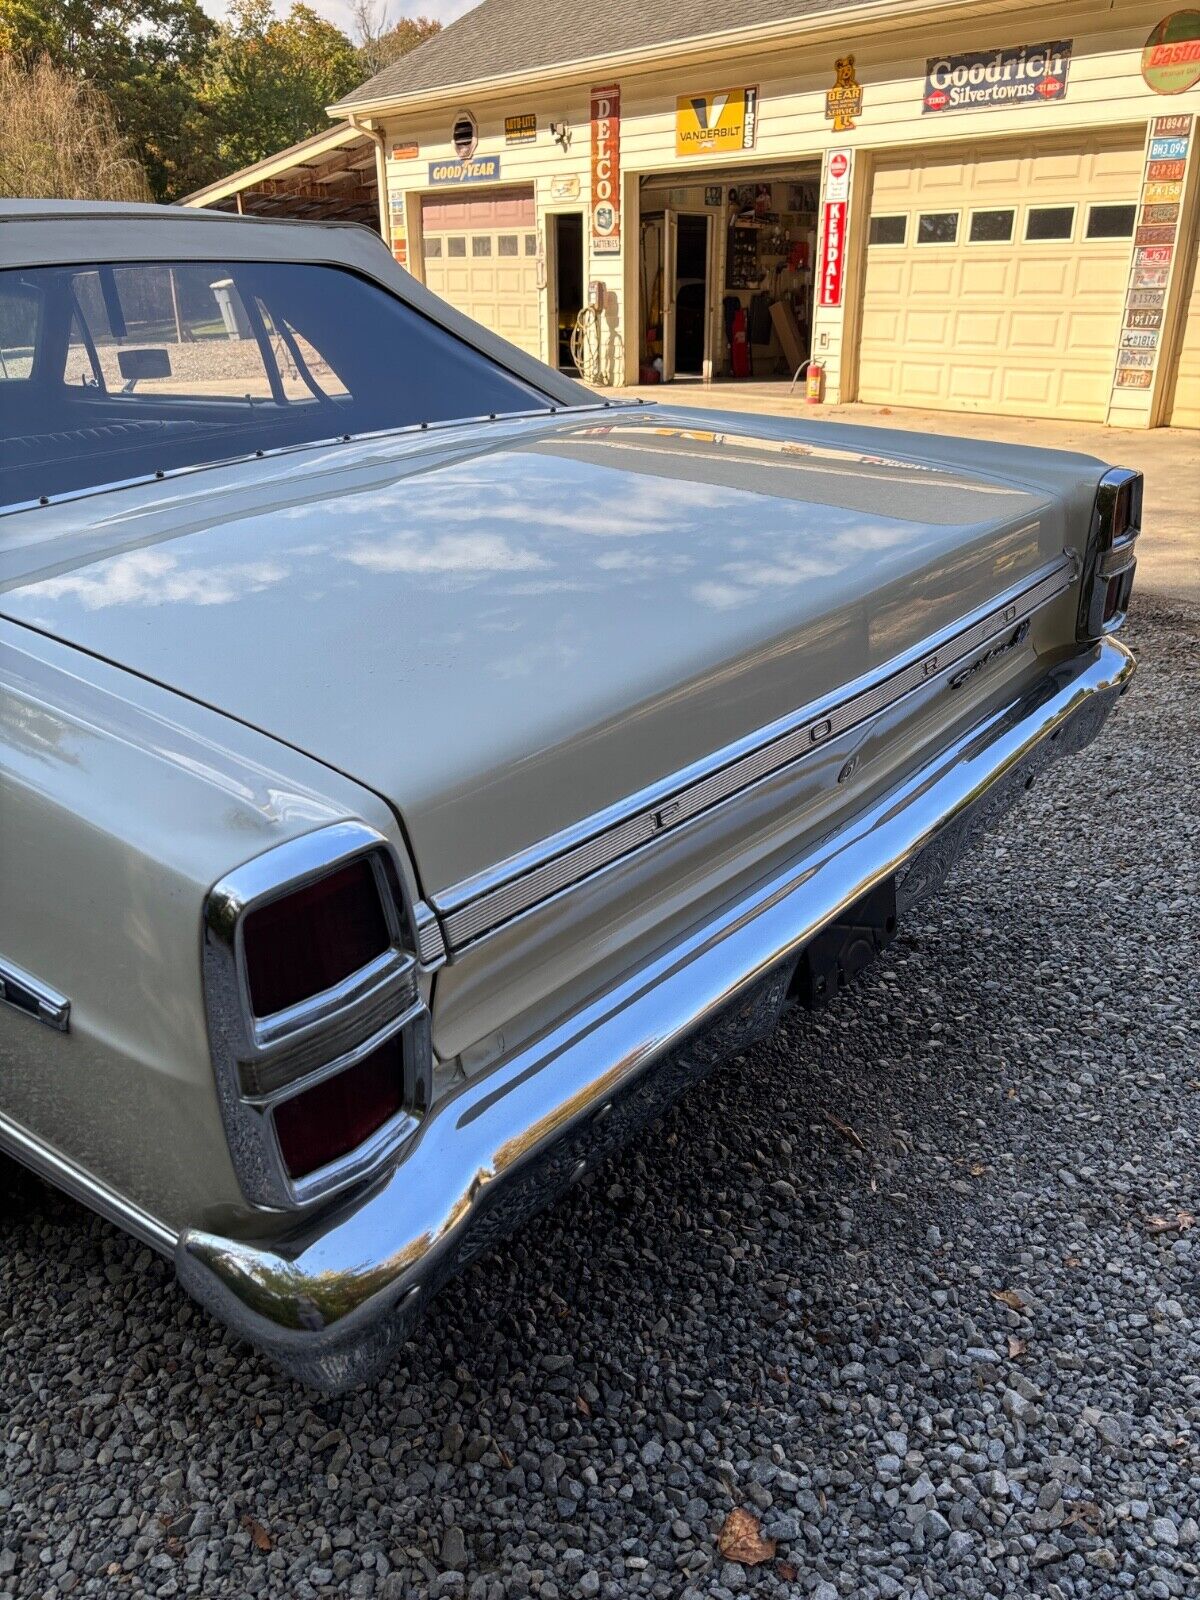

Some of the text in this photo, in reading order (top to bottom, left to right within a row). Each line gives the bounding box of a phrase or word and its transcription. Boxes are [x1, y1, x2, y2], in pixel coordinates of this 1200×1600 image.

[929, 49, 1063, 90] Goodrich
[828, 90, 860, 101] BEAR
[949, 82, 1035, 106] Silvertowns
[744, 89, 756, 148] TIRES
[680, 126, 741, 141] VANDERBILT
[596, 99, 612, 200] DELCO
[433, 161, 494, 181] GOODYEAR
[593, 239, 618, 249] BATTERIES
[824, 203, 840, 304] KENDALL
